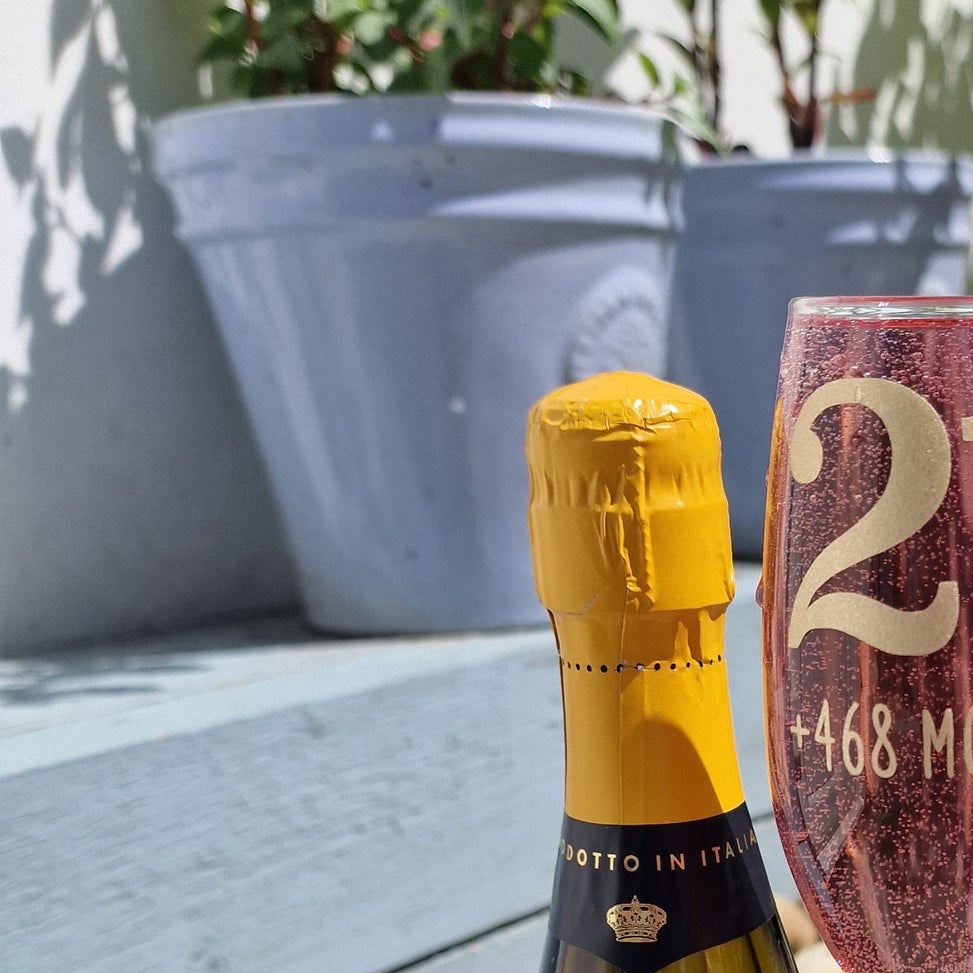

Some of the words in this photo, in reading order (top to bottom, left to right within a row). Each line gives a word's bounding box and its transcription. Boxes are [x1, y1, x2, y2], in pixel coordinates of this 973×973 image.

[789, 698, 898, 780] +468
[655, 853, 686, 872] IN
[700, 828, 757, 867] ITALIA
